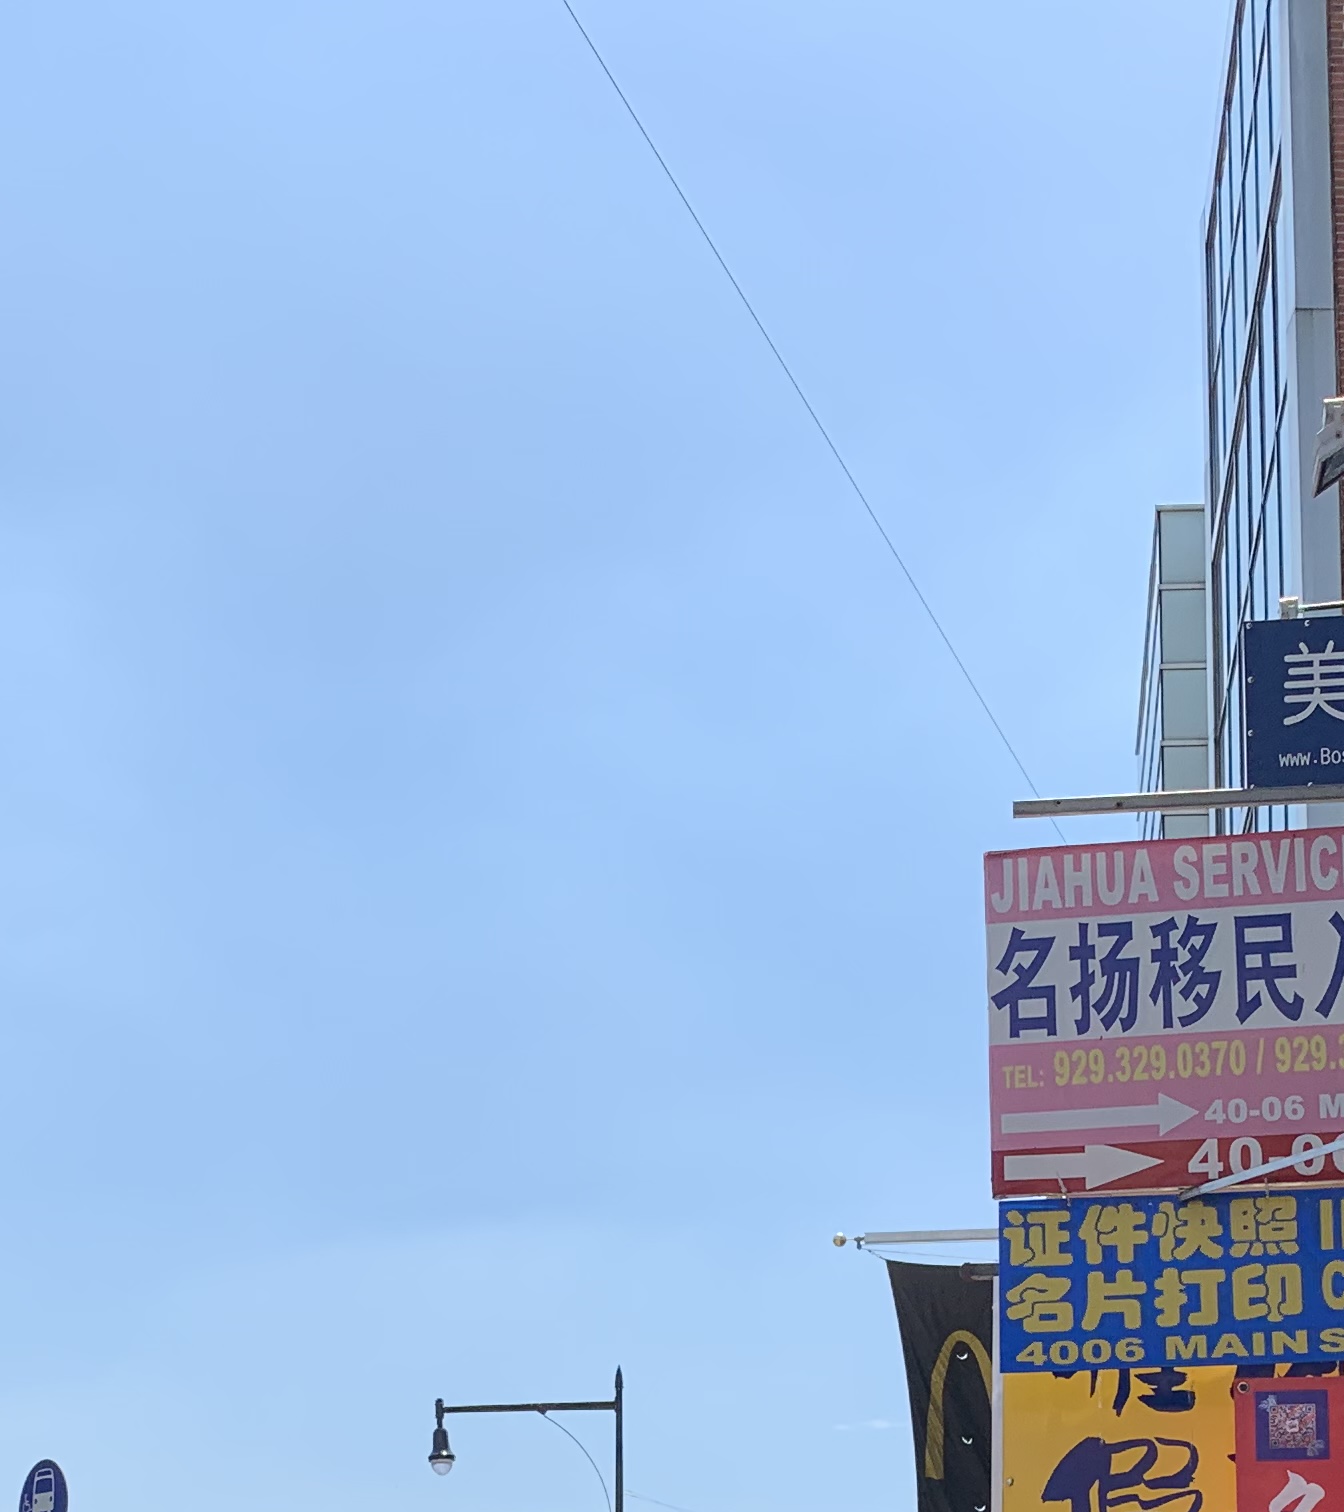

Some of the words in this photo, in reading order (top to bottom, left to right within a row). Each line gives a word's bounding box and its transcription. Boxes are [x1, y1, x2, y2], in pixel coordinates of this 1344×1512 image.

[991, 848, 1159, 913] JIAHUA
[1002, 1065, 1045, 1089] TEL:
[1054, 1039, 1247, 1086] 929.329.0370
[1204, 1095, 1305, 1126] 40-06
[1003, 1196, 1299, 1269] 证件快照
[1005, 1263, 1302, 1334] 名片打印
[1015, 1338, 1144, 1368] 4006
[1166, 1328, 1309, 1362] MAIN
